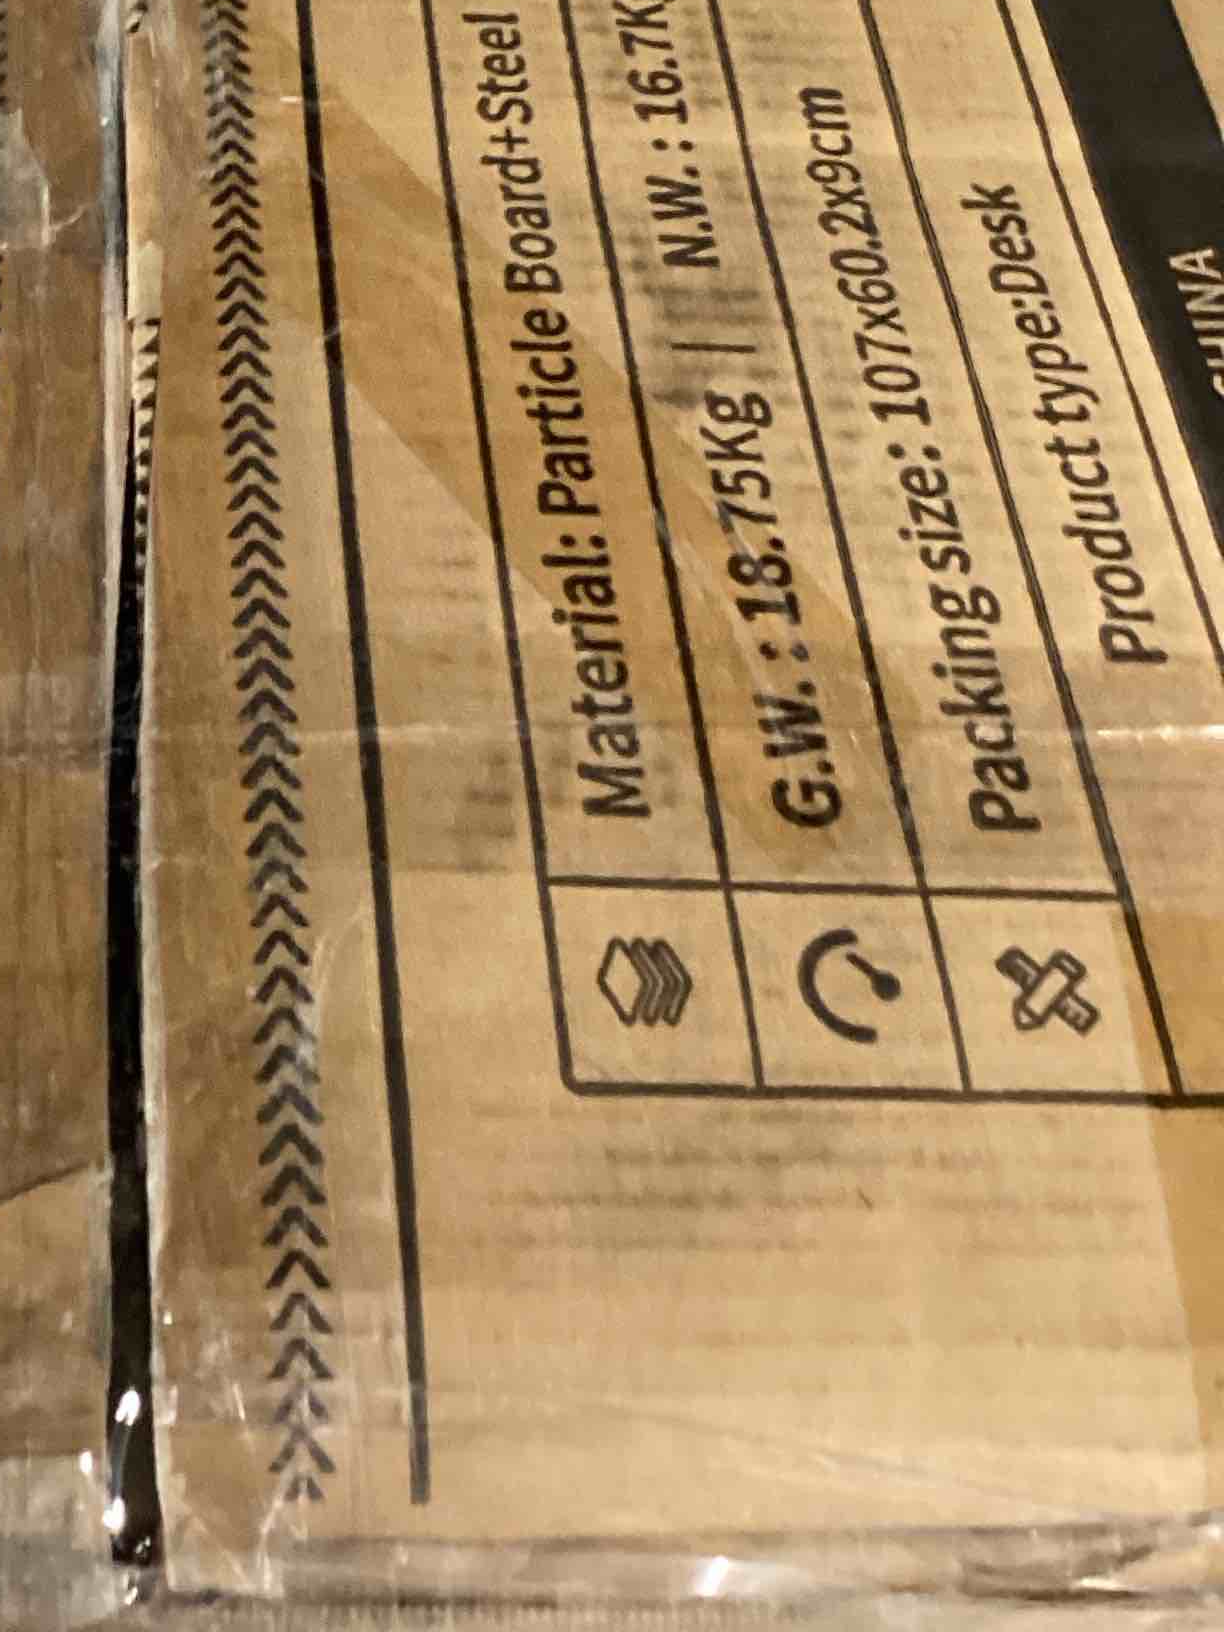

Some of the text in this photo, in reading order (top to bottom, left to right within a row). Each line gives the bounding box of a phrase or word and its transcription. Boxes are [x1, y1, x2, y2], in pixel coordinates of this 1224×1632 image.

[461, 9, 652, 821] Material: Particle Board+Steel
[696, 390, 801, 627] 18.75Kg
[791, 85, 1043, 835] Packing size: 107x60.2x9cm
[959, 181, 1168, 667] Product type:Desk
